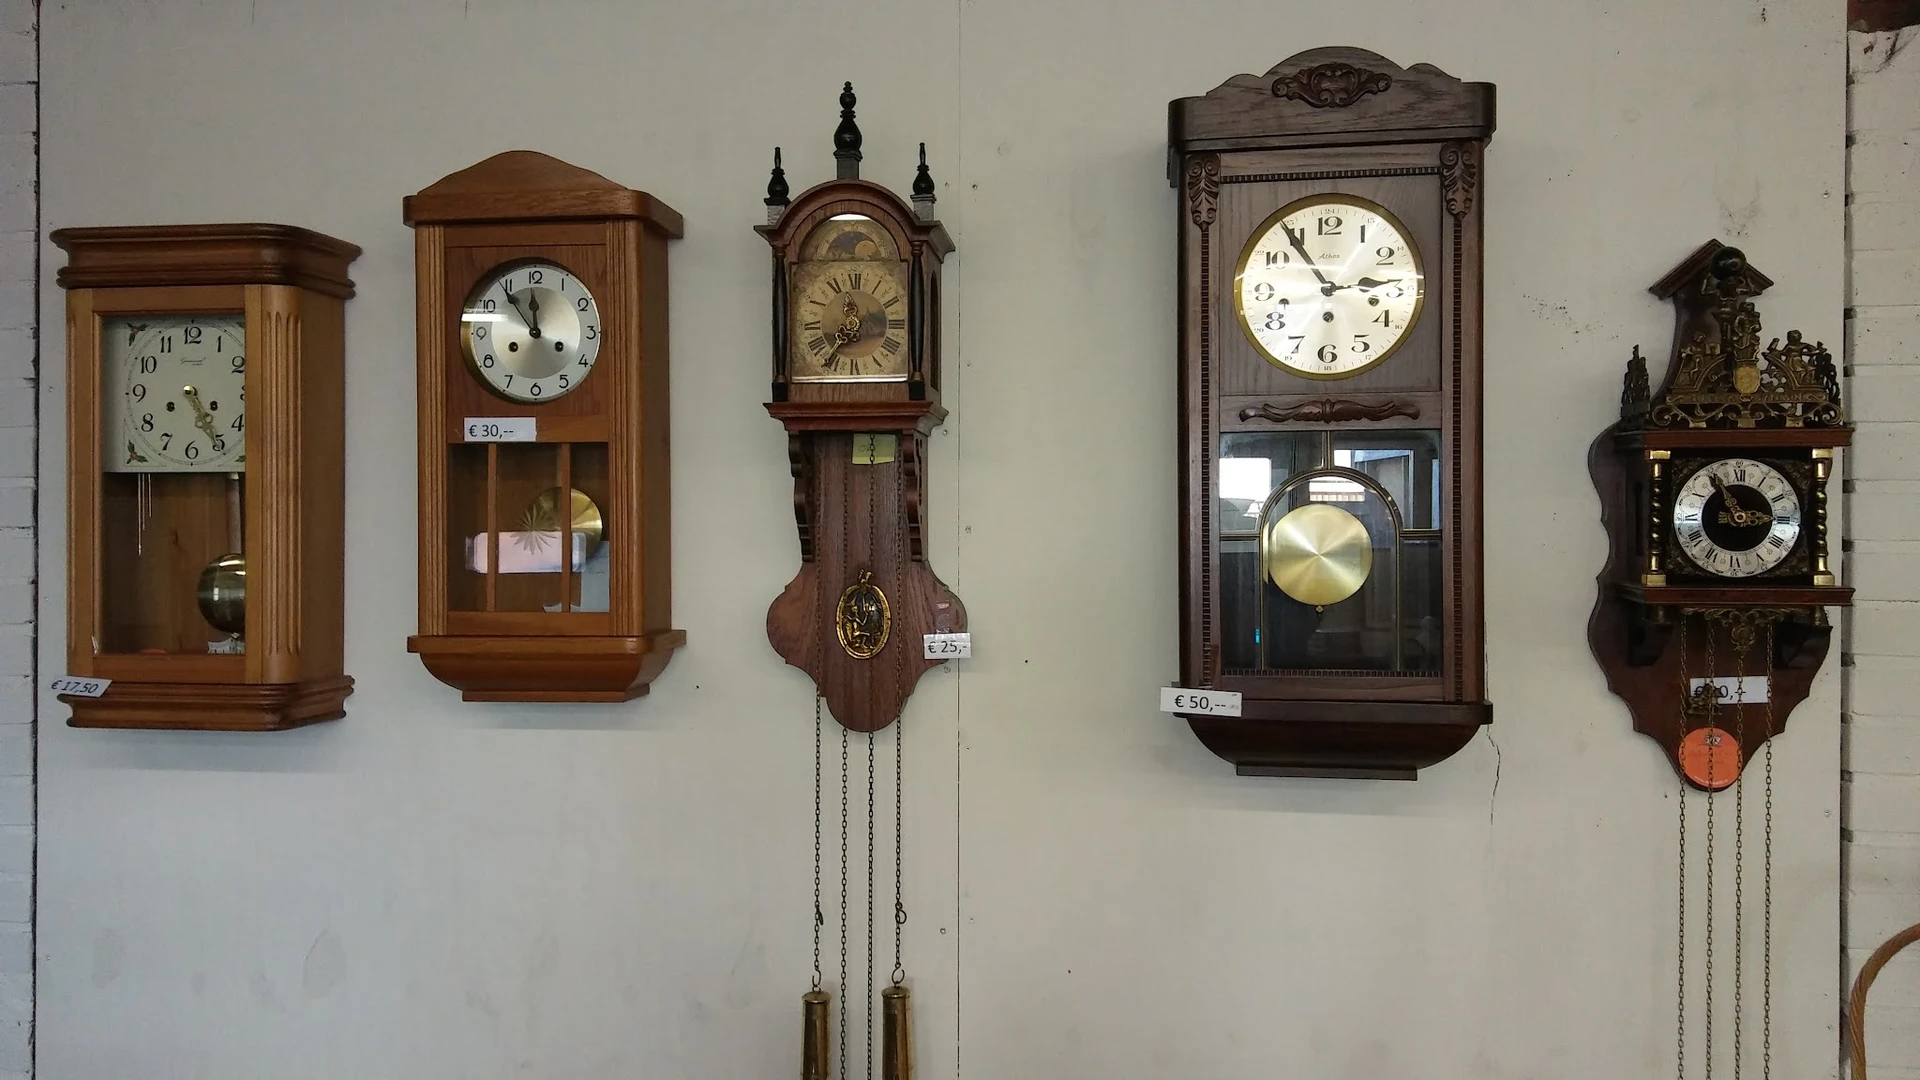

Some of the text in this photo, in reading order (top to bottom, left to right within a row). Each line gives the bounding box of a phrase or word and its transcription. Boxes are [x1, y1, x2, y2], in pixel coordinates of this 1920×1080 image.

[1317, 216, 1343, 236] 12
[1360, 224, 1366, 244] 1
[1265, 250, 1291, 270] 10
[1375, 246, 1395, 266] 2
[505, 278, 513, 292] 11
[529, 270, 543, 284] 12
[561, 278, 565, 291] 1
[1254, 282, 1275, 301] 9
[1386, 278, 1404, 299] 3
[483, 299, 496, 313] 10
[577, 297, 589, 312] 2
[882, 295, 900, 310] II
[888, 319, 905, 330] III
[1265, 311, 1286, 331] 8
[1371, 309, 1394, 328] 4
[184, 326, 202, 345] 12
[475, 326, 487, 340] 9
[585, 325, 597, 340] 3
[160, 335, 172, 353] 11
[217, 335, 222, 353] 1
[880, 335, 901, 356] IIII
[1288, 335, 1306, 354] 7
[1351, 334, 1370, 354] 5
[483, 354, 494, 368] 8
[577, 354, 589, 368] 4
[1317, 344, 1338, 364] 6
[140, 356, 157, 374] 10
[231, 356, 245, 374] 2
[504, 374, 513, 388] 7
[530, 382, 542, 397] 6
[558, 374, 569, 389] 5
[132, 384, 147, 403] 9
[141, 413, 154, 432] 8
[231, 414, 245, 432] 4
[468, 424, 514, 439] € 30,--
[160, 433, 173, 451] 7
[185, 440, 199, 460] 6
[212, 434, 226, 452] 5
[1733, 469, 1746, 482] XII
[1771, 493, 1785, 503] II
[1776, 516, 1790, 525] III
[1768, 534, 1785, 549] IIII
[928, 640, 968, 655] € 25,-
[51, 680, 99, 693] € 17,50
[1174, 694, 1227, 712] € 50,--
